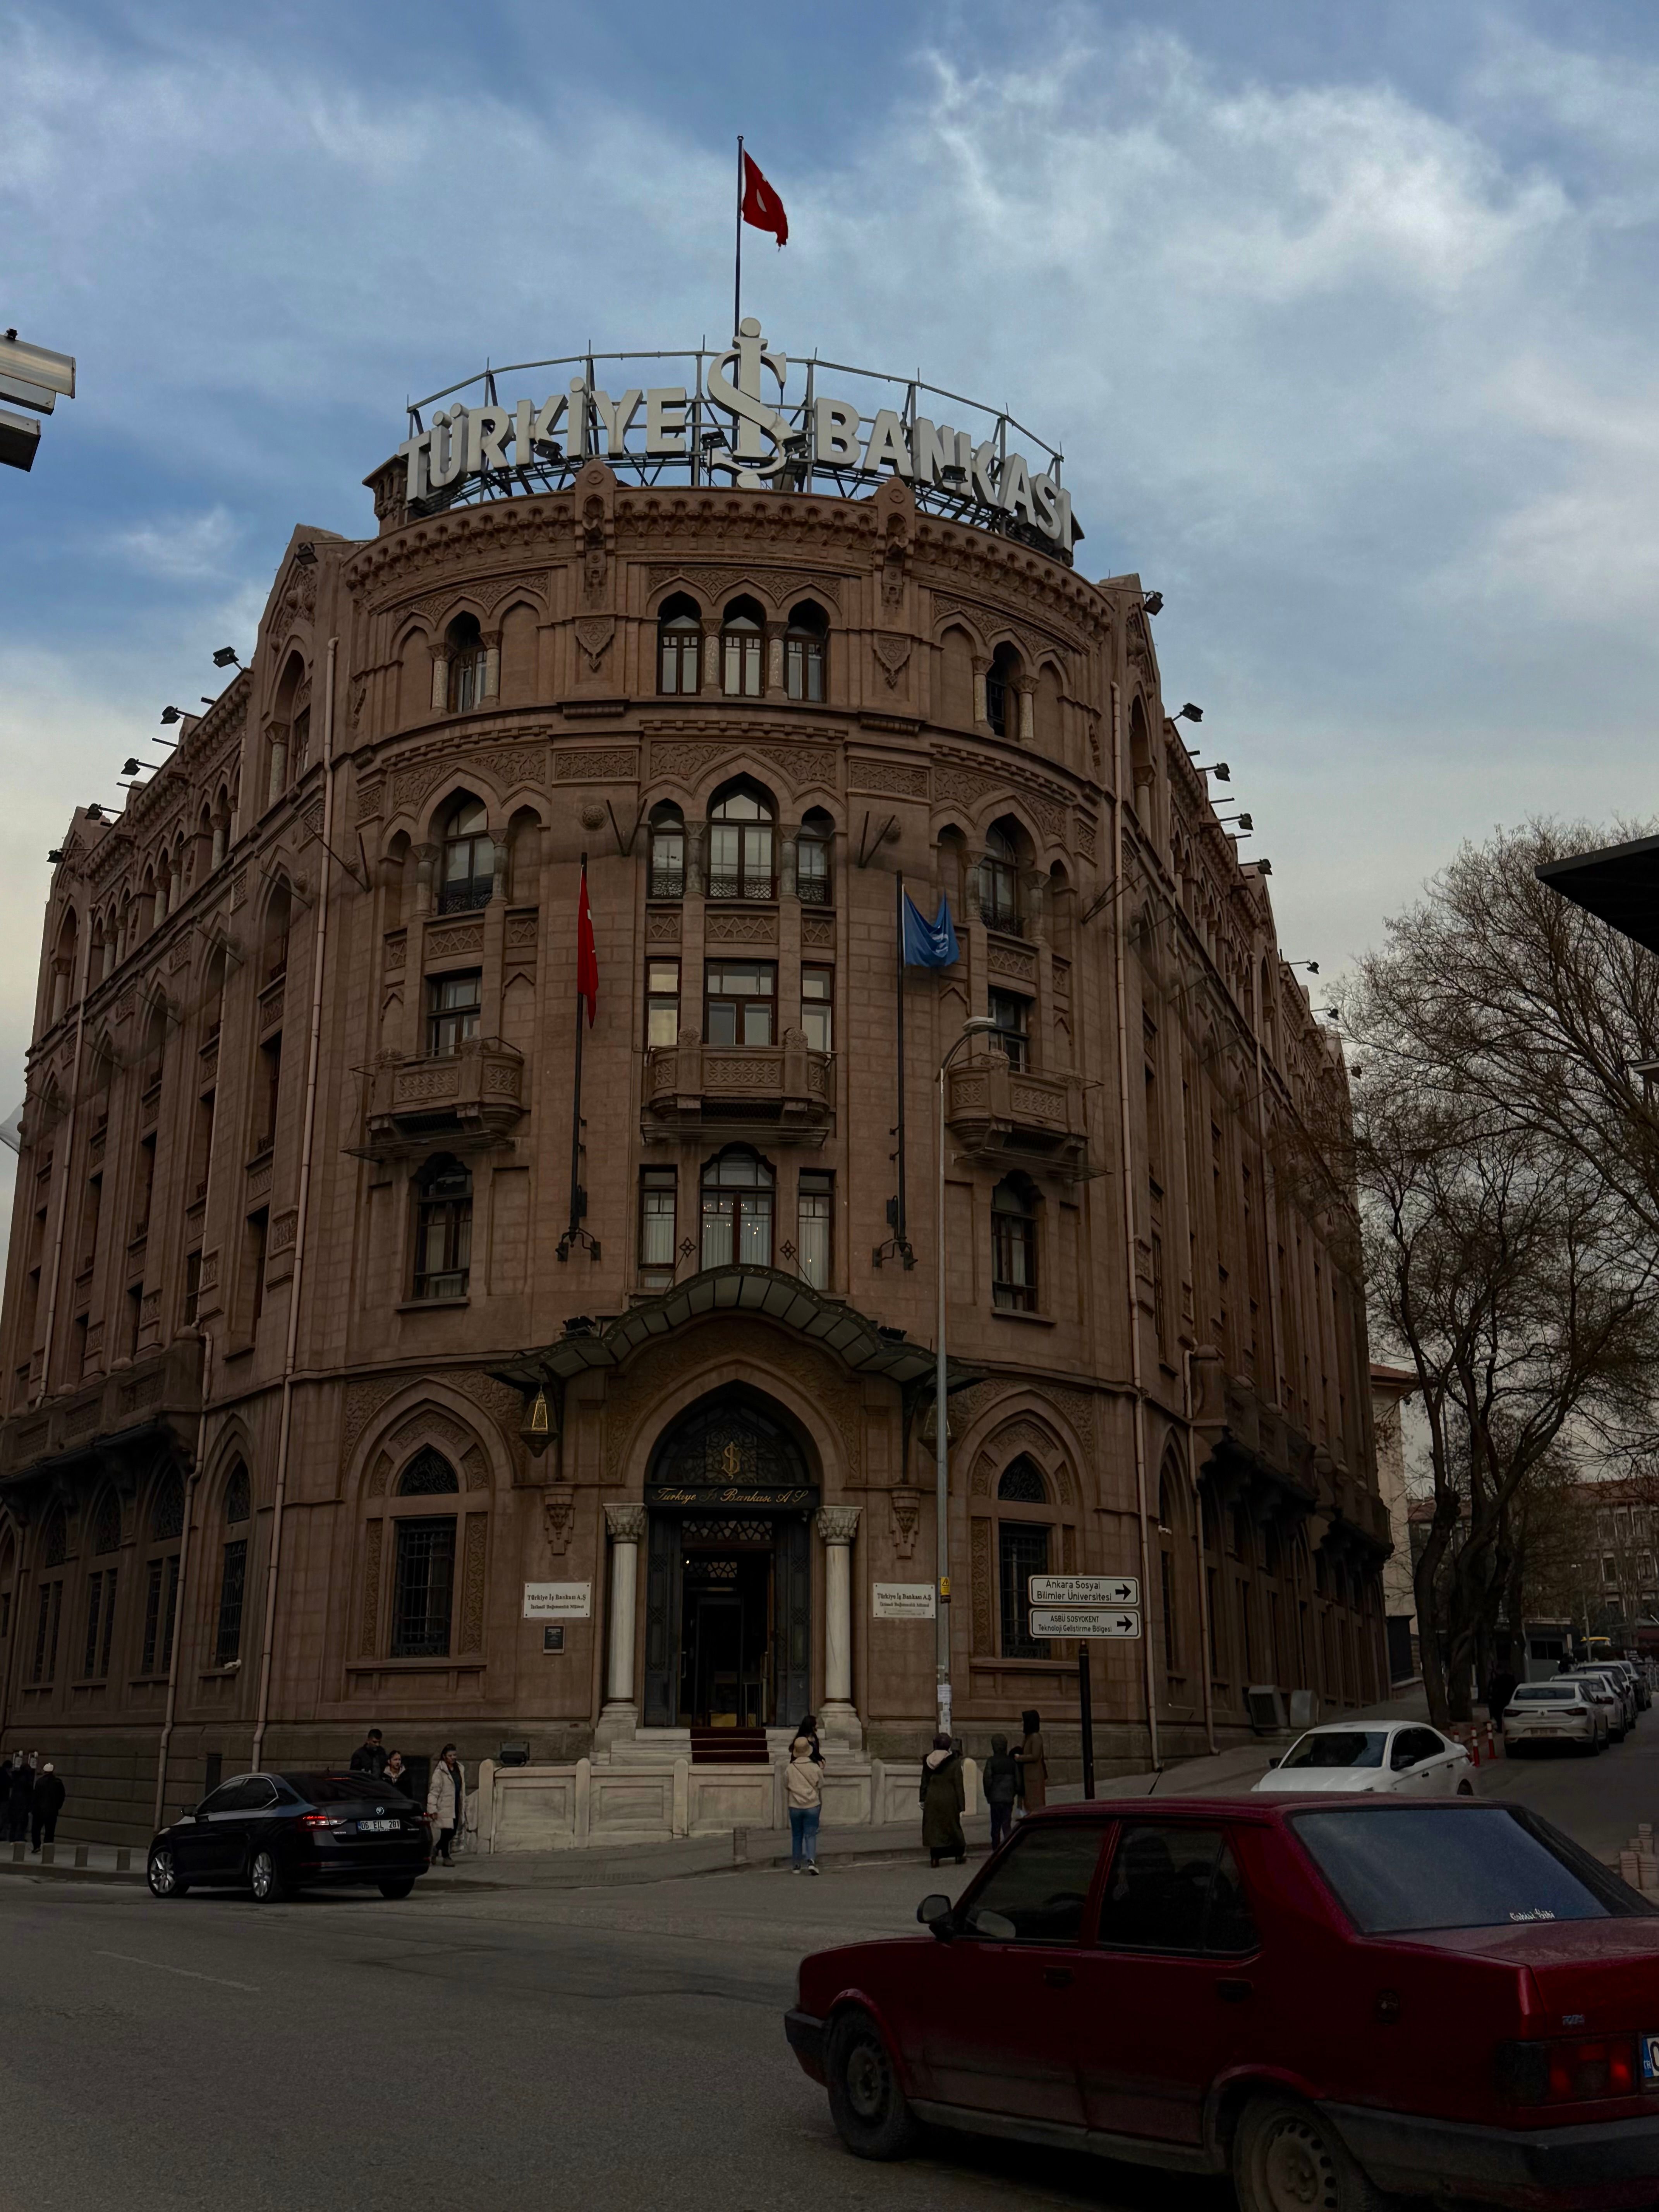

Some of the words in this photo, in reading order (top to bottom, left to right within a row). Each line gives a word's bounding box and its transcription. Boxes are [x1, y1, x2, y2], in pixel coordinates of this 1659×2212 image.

[400, 377, 687, 505] TÜRKİYE
[813, 397, 1073, 553] BANKASI
[1046, 1580, 1073, 1589] Ankara
[1075, 1581, 1100, 1590] Sosyal
[1037, 1591, 1066, 1600] Bilimler
[1068, 1590, 1111, 1601] Üniversitesi
[1050, 1614, 1065, 1622] ASBÜ
[1038, 1625, 1062, 1633] Teknoloji
